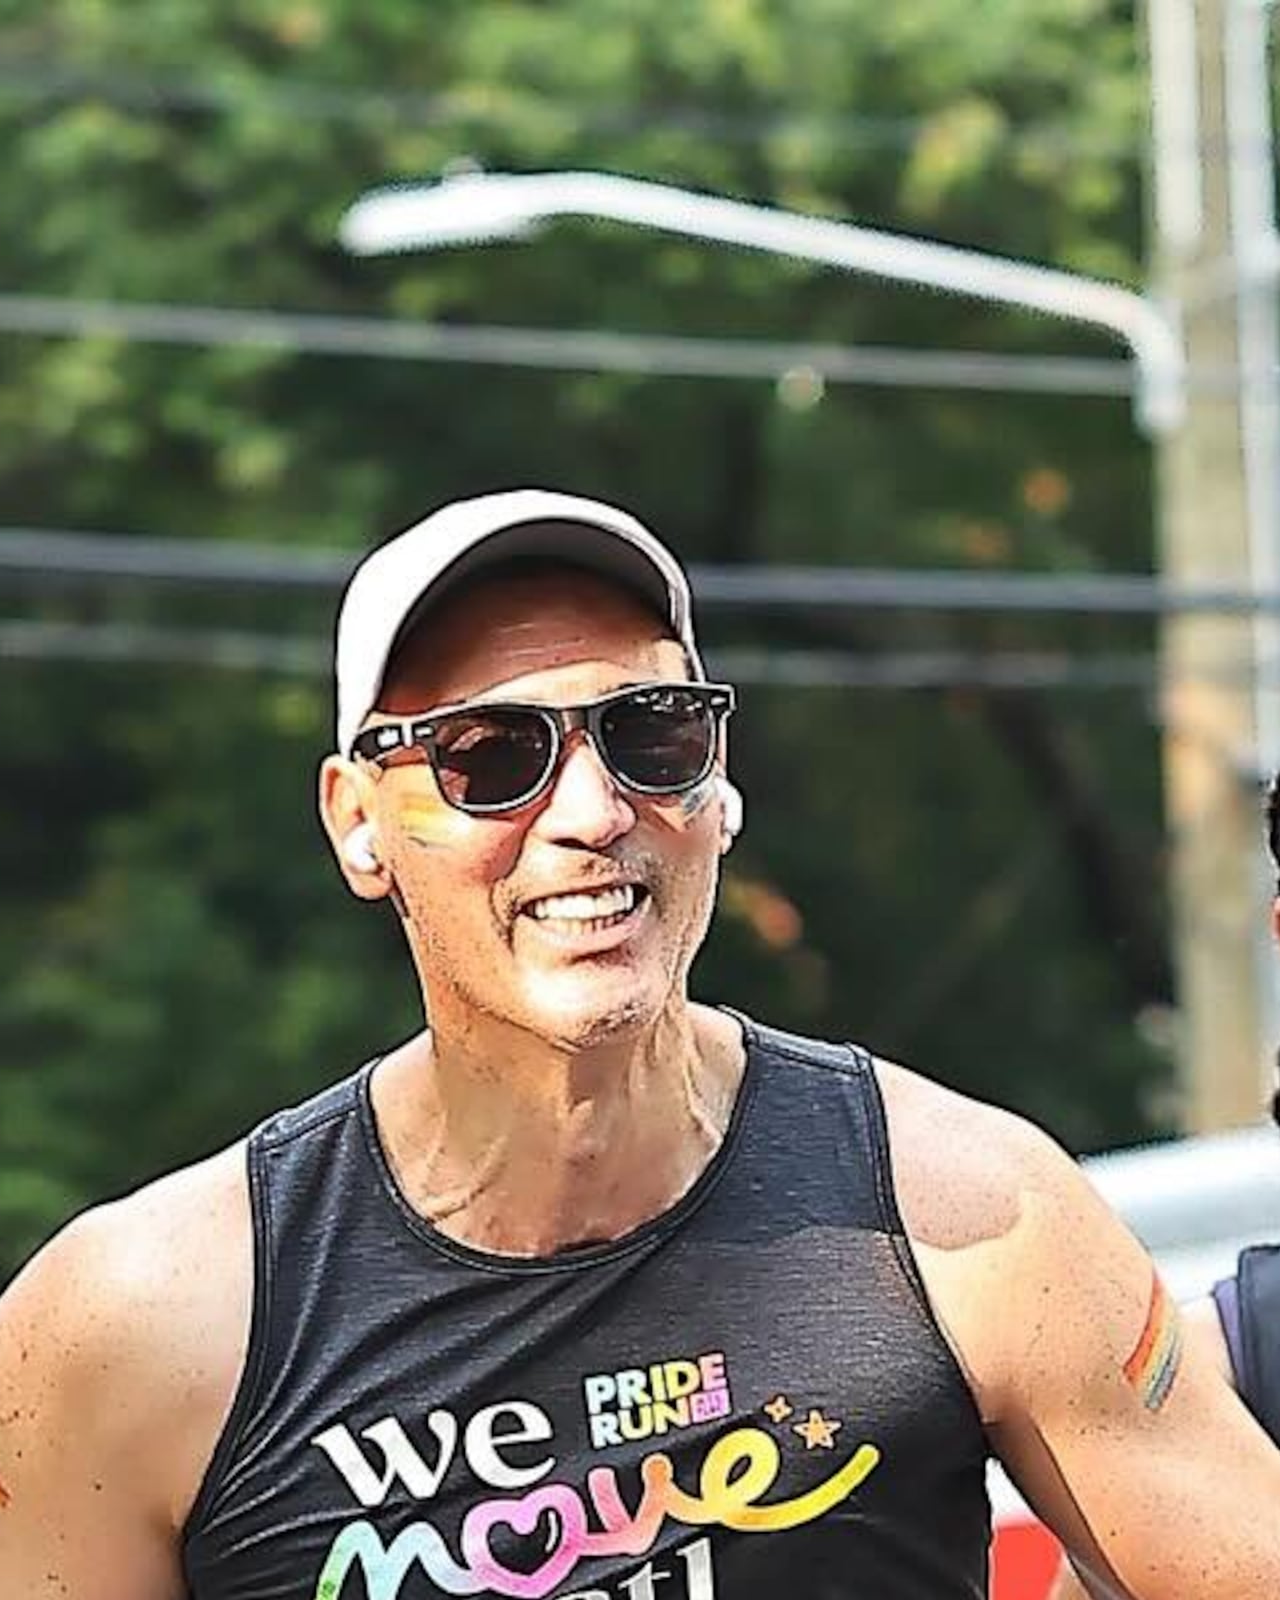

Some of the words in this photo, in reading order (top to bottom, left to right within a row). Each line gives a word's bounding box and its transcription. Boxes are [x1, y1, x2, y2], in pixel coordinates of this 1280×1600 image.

[585, 1352, 727, 1414] PRIDE
[590, 1396, 691, 1449] RUN
[312, 1401, 556, 1507] we
